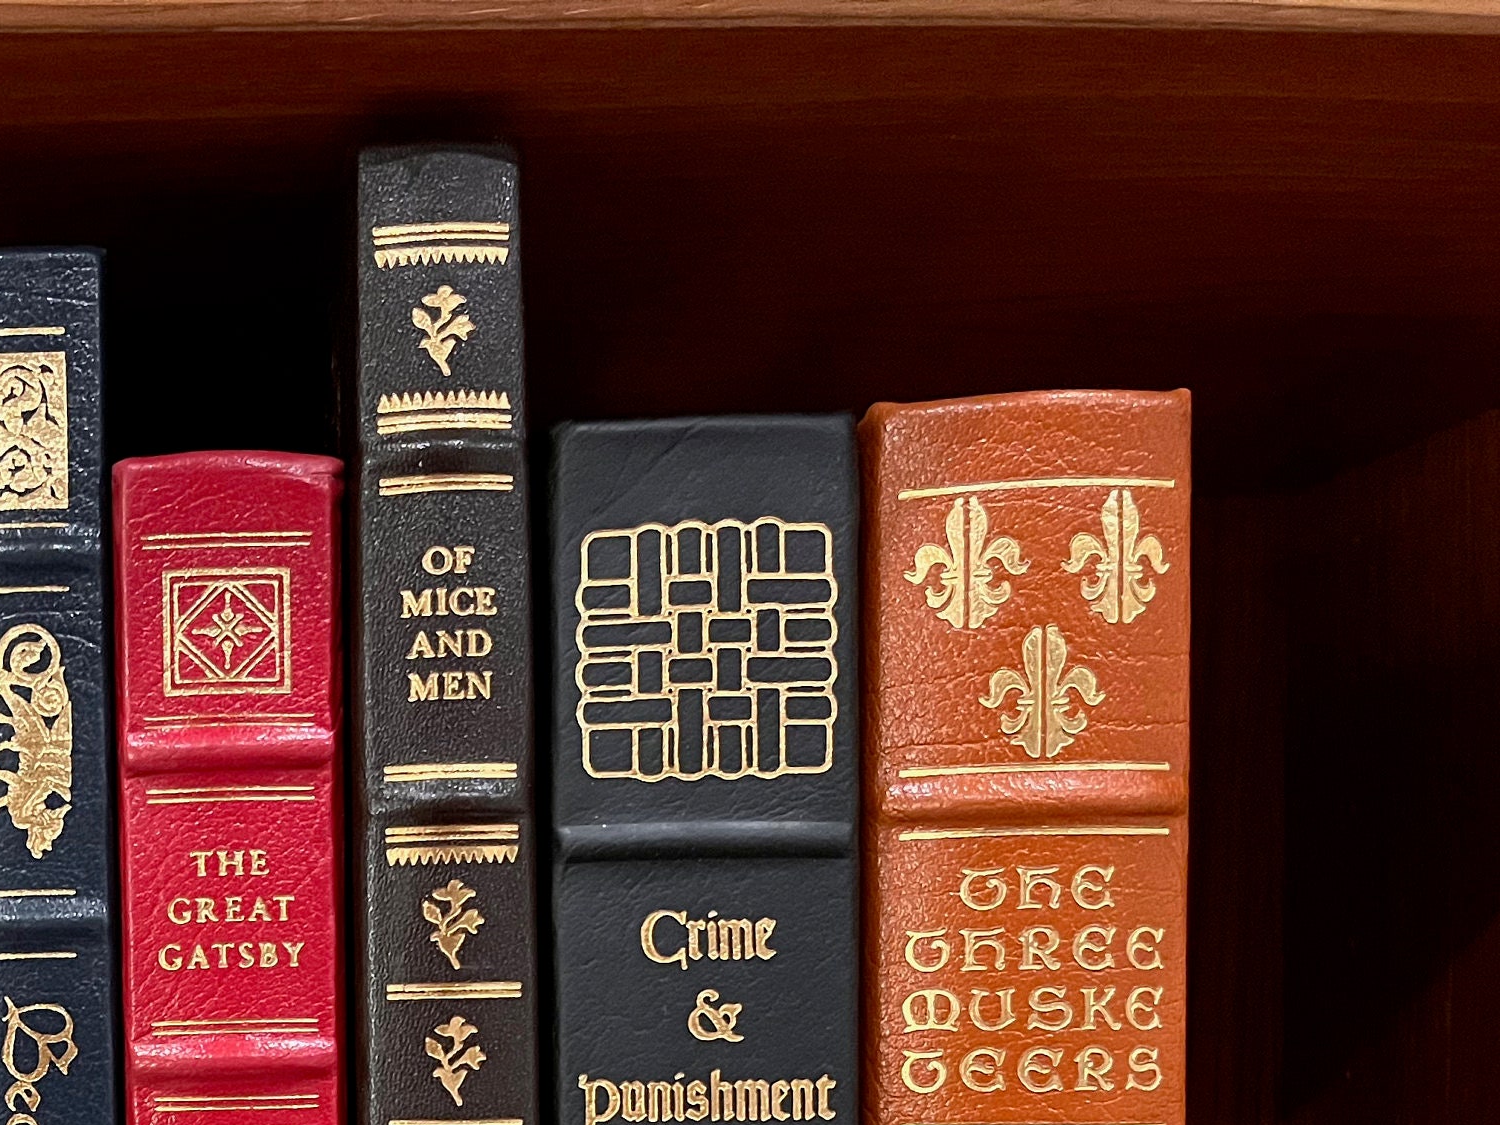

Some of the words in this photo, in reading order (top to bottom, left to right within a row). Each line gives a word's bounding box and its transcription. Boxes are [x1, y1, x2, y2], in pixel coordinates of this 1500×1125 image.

[421, 545, 476, 576] OF
[399, 586, 498, 619] MICE
[405, 628, 493, 660] AND
[407, 670, 493, 703] MEN
[188, 848, 270, 877] THE
[959, 865, 1116, 911] THE
[167, 894, 296, 925] GREAT
[158, 941, 305, 971] GATSBY
[640, 909, 777, 971] Crime
[904, 926, 1166, 973] THREE
[687, 988, 745, 1043] &
[901, 986, 1164, 1033] MUSKE
[900, 1046, 1164, 1094] TEERS
